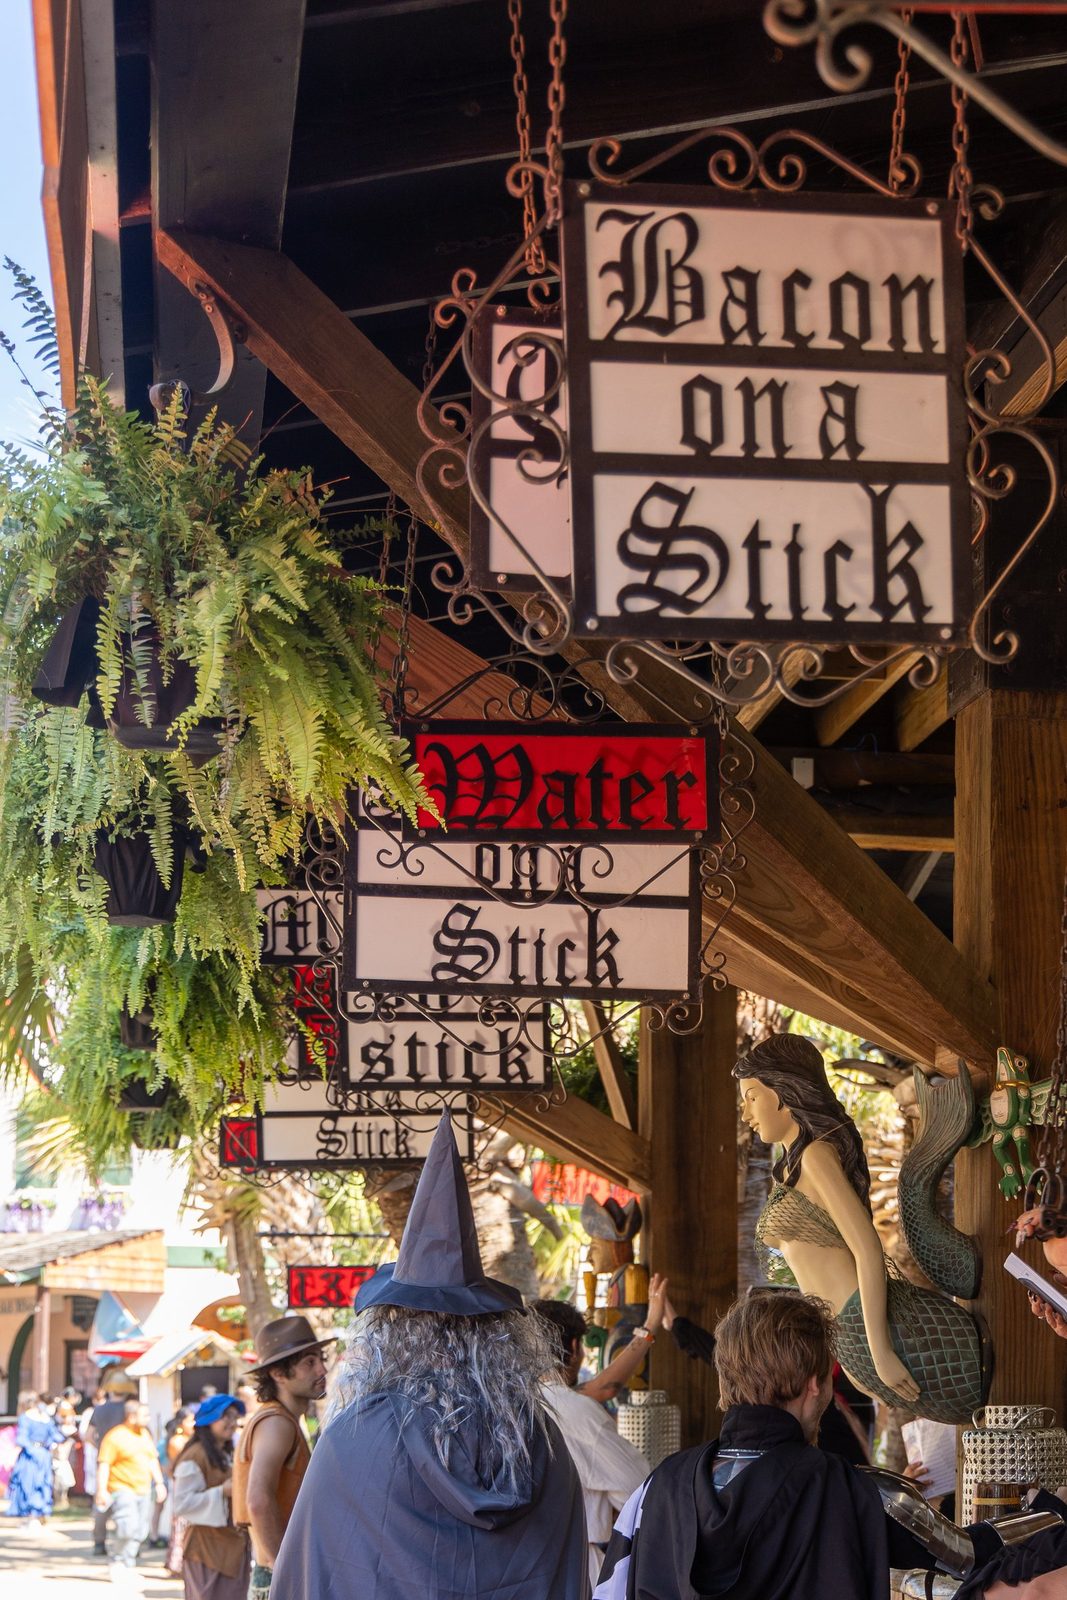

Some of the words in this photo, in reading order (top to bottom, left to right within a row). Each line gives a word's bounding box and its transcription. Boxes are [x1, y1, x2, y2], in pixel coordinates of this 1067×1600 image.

[596, 208, 938, 354] Bacon
[679, 373, 793, 459] on
[817, 380, 867, 460] a
[615, 481, 934, 624] Stick
[423, 742, 698, 829] Water
[475, 843, 542, 892] on
[558, 844, 586, 893] a
[431, 902, 625, 989] Stick
[360, 1027, 534, 1084] stick
[315, 1116, 412, 1161] Stick
